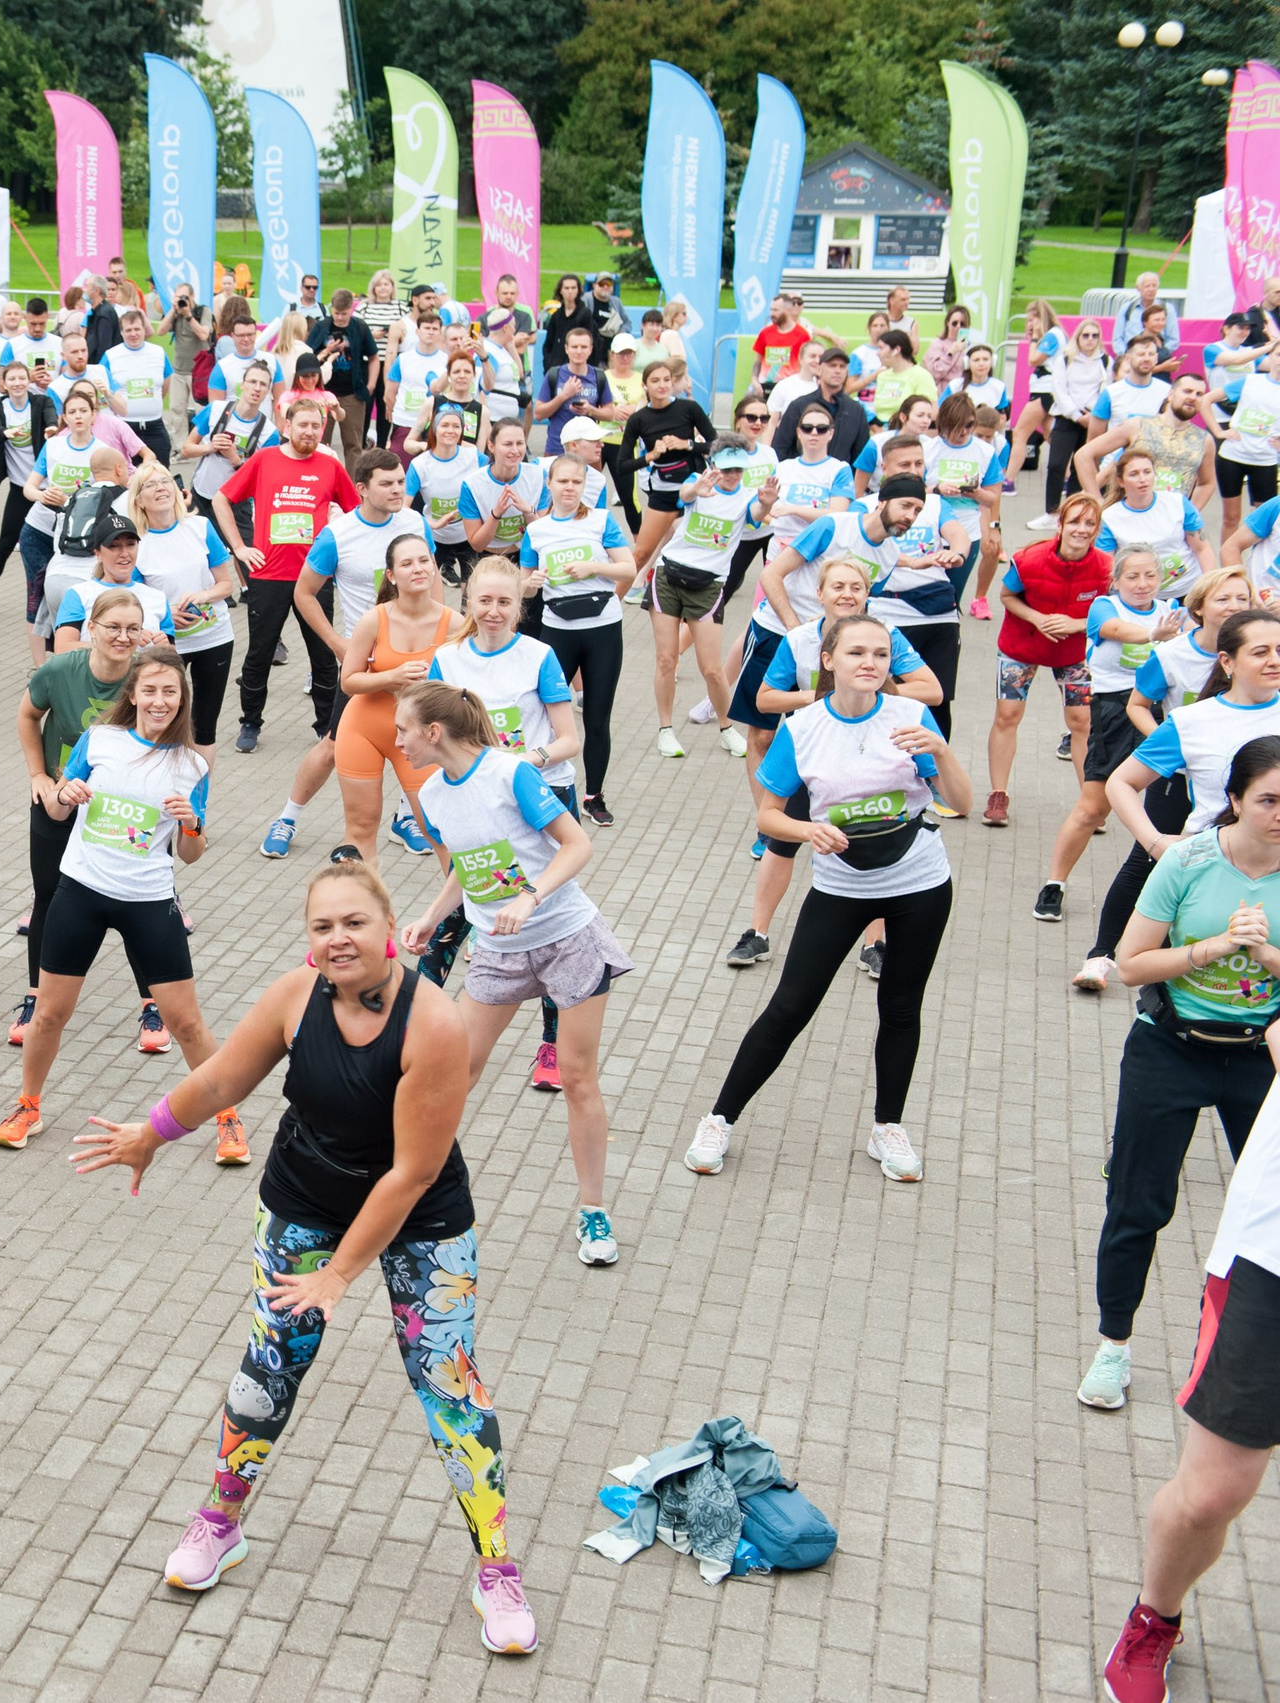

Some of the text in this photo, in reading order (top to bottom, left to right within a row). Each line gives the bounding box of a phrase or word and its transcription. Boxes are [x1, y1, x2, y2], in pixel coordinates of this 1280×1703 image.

[59, 465, 85, 478] 1304
[282, 485, 310, 494] Я БЕГУ
[794, 484, 822, 497] 3129
[277, 514, 306, 526] 1234
[699, 516, 724, 531] 1173
[551, 548, 585, 565] 1090
[102, 797, 147, 823] 1303
[840, 796, 893, 821] 1560
[458, 848, 501, 872] 1552
